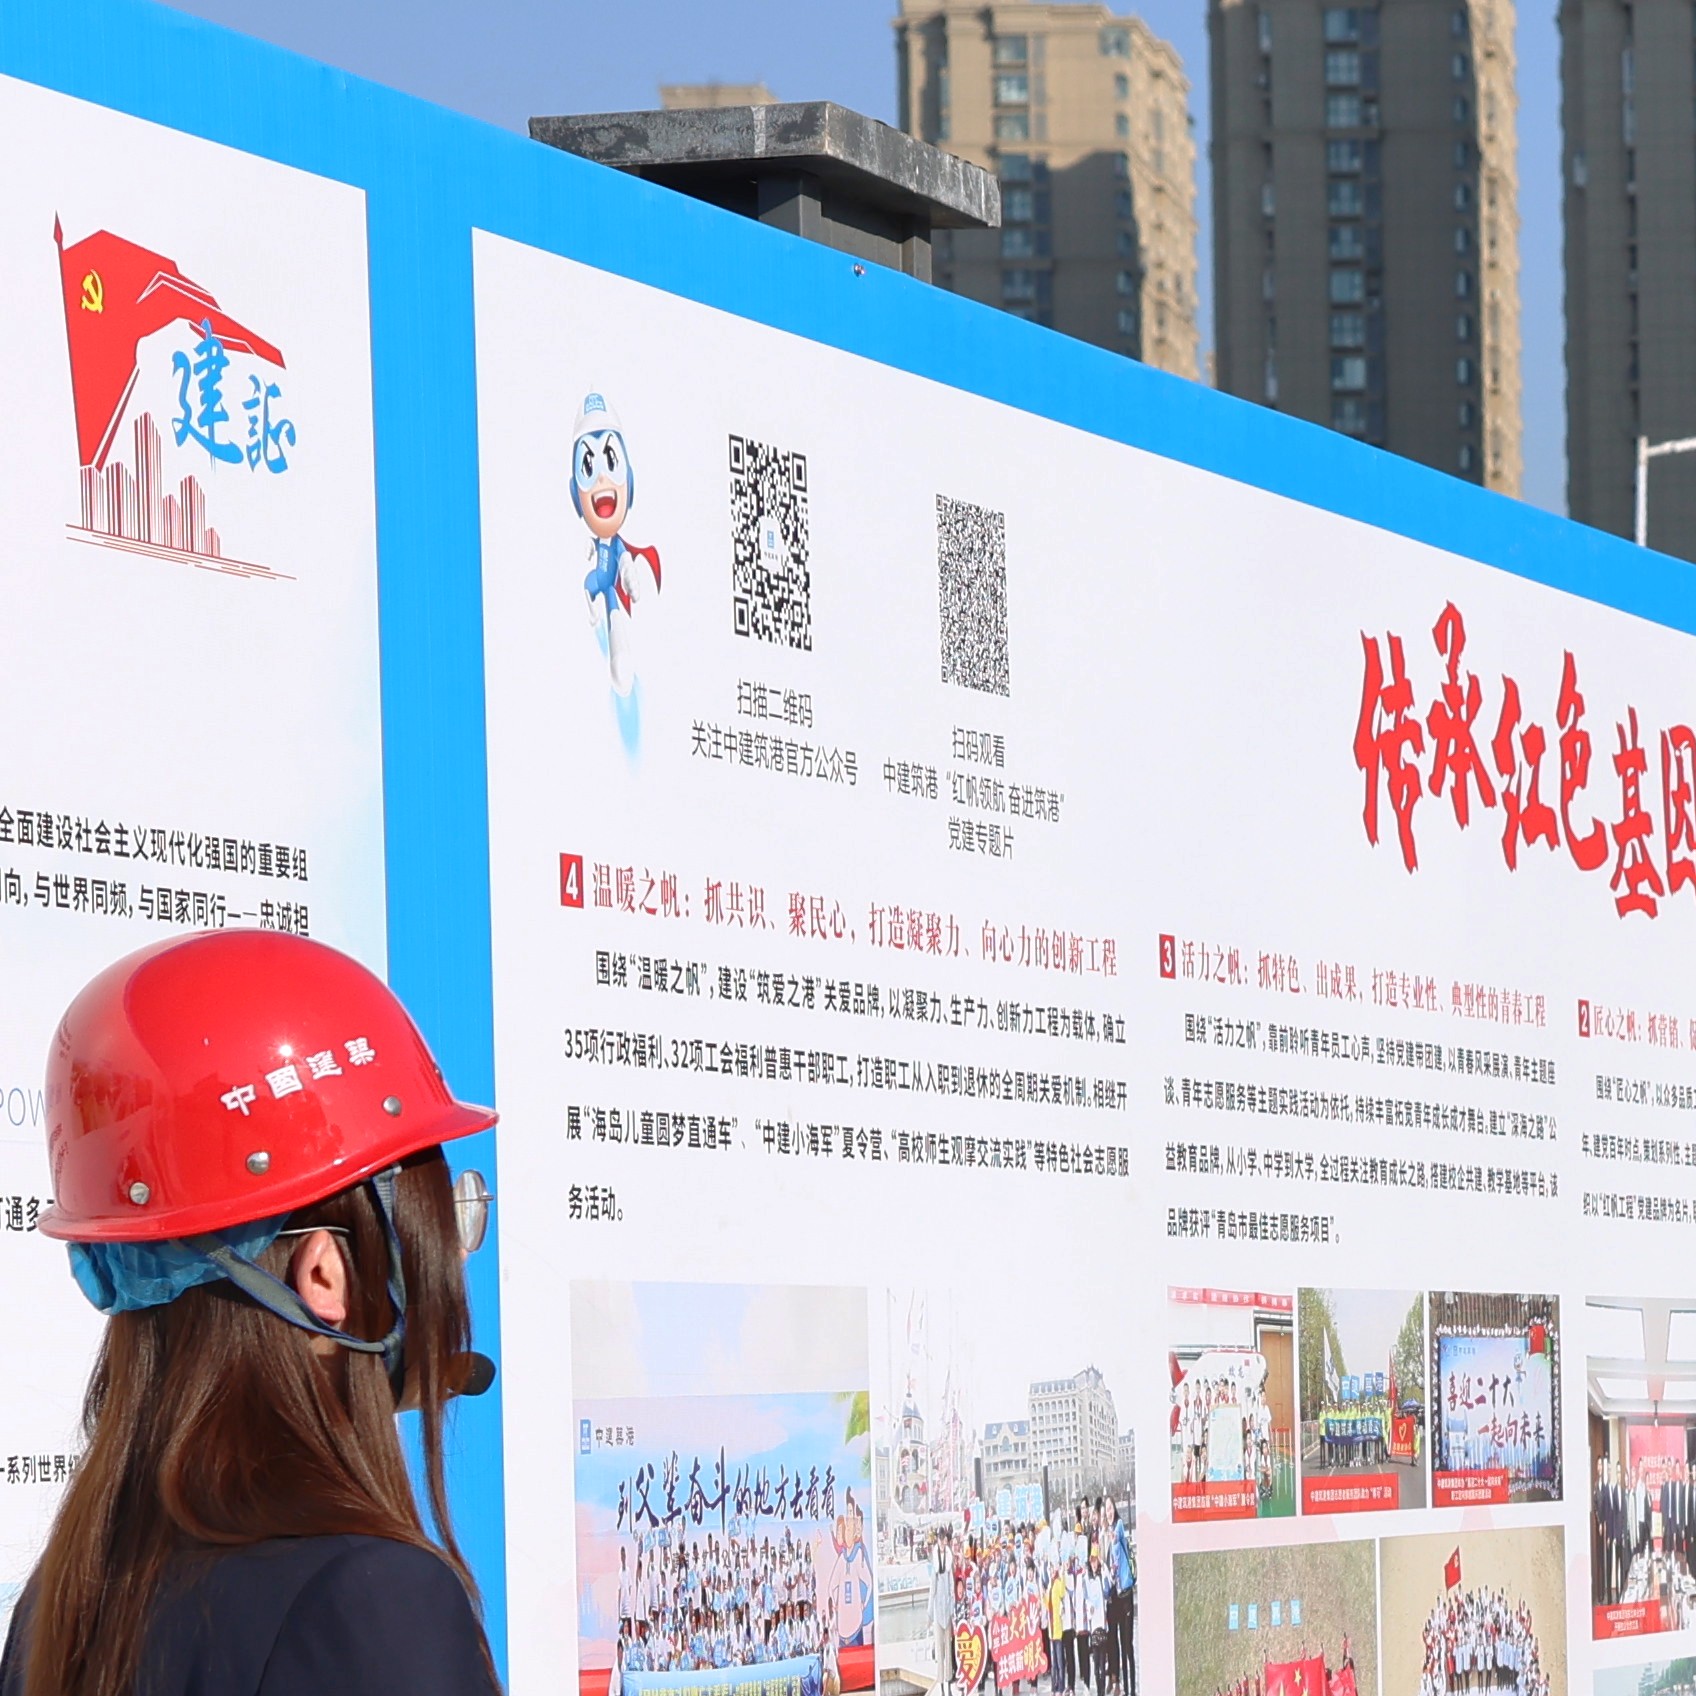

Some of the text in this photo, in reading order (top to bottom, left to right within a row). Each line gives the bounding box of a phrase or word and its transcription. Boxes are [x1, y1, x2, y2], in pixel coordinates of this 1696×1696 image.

[737, 678, 813, 728] 扫描二维码
[692, 720, 858, 786] 关注中建筑港官方公众号
[953, 725, 1006, 768] 扫码观看
[0, 806, 309, 881] 全面建设社会主义现代化强国的重要组
[949, 816, 1014, 859] 党建专题片
[565, 862, 579, 901] 4
[1163, 949, 1174, 975] 3
[0, 1087, 47, 1126] OW
[568, 1184, 624, 1223] 务活动。
[616, 1446, 837, 1533] 到父辈奋斗的地方去看看
